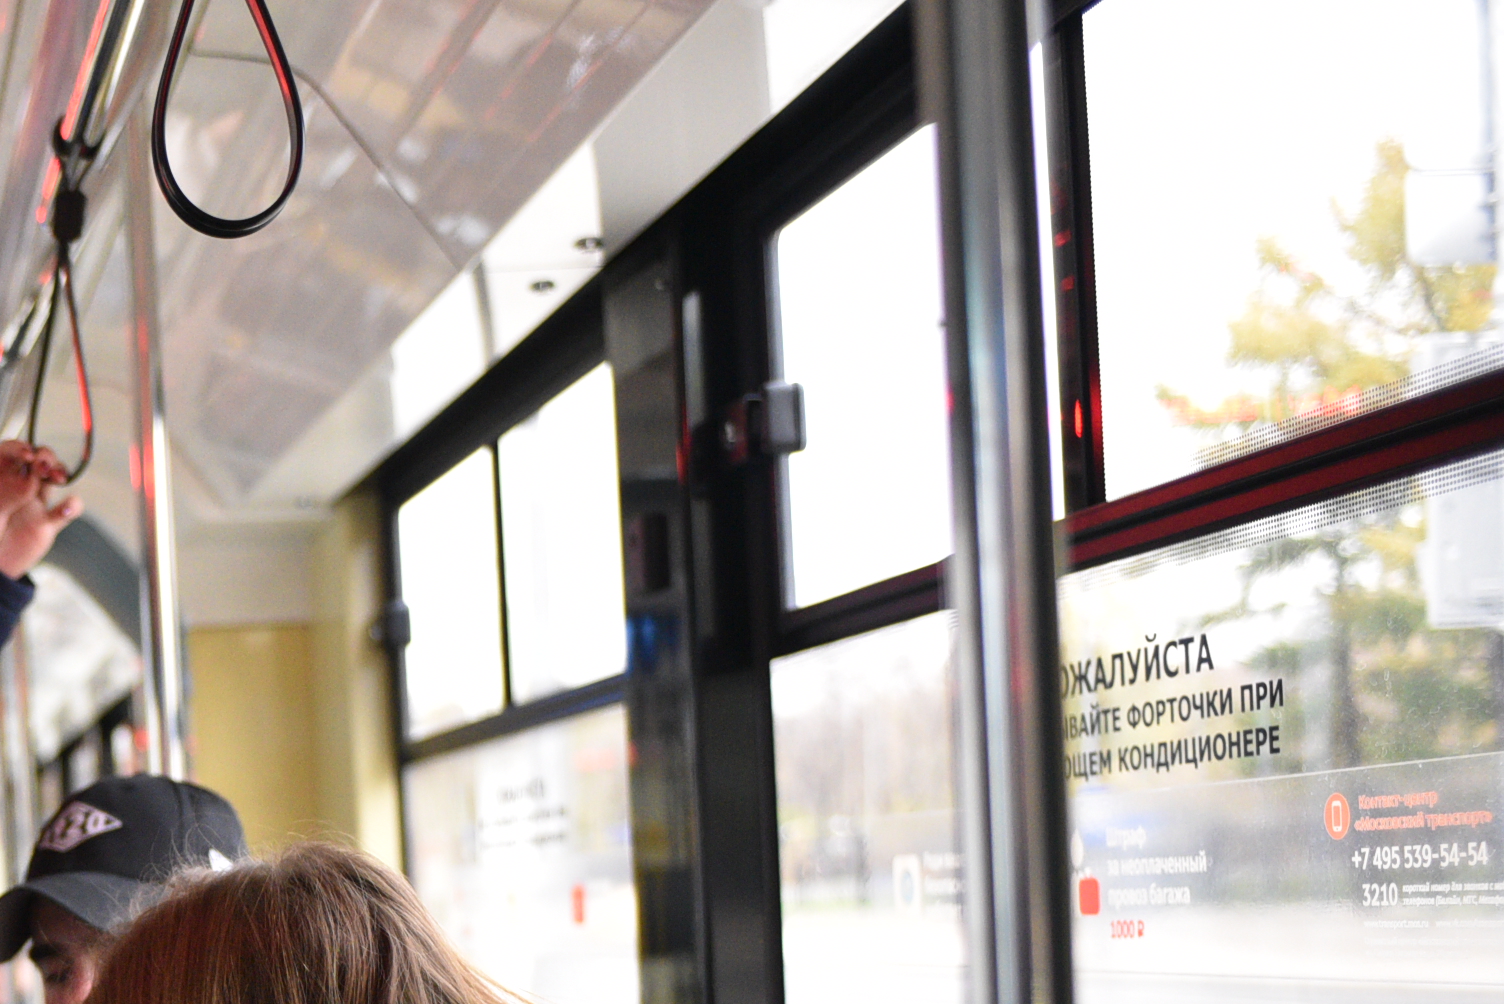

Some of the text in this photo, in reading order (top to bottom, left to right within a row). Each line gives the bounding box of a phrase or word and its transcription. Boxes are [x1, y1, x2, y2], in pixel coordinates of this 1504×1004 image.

[1127, 687, 1234, 729] ФОРТОЧКИ
[1240, 678, 1284, 713] ПРИ
[1118, 725, 1281, 773] КОНДИЦИОНЕРЕ
[1358, 791, 1438, 809] Контакт-центр
[1352, 841, 1488, 870] +7 495 539-54-54
[1149, 882, 1191, 904] багажа
[1362, 882, 1398, 907] 3210
[1111, 920, 1135, 938] 1000
